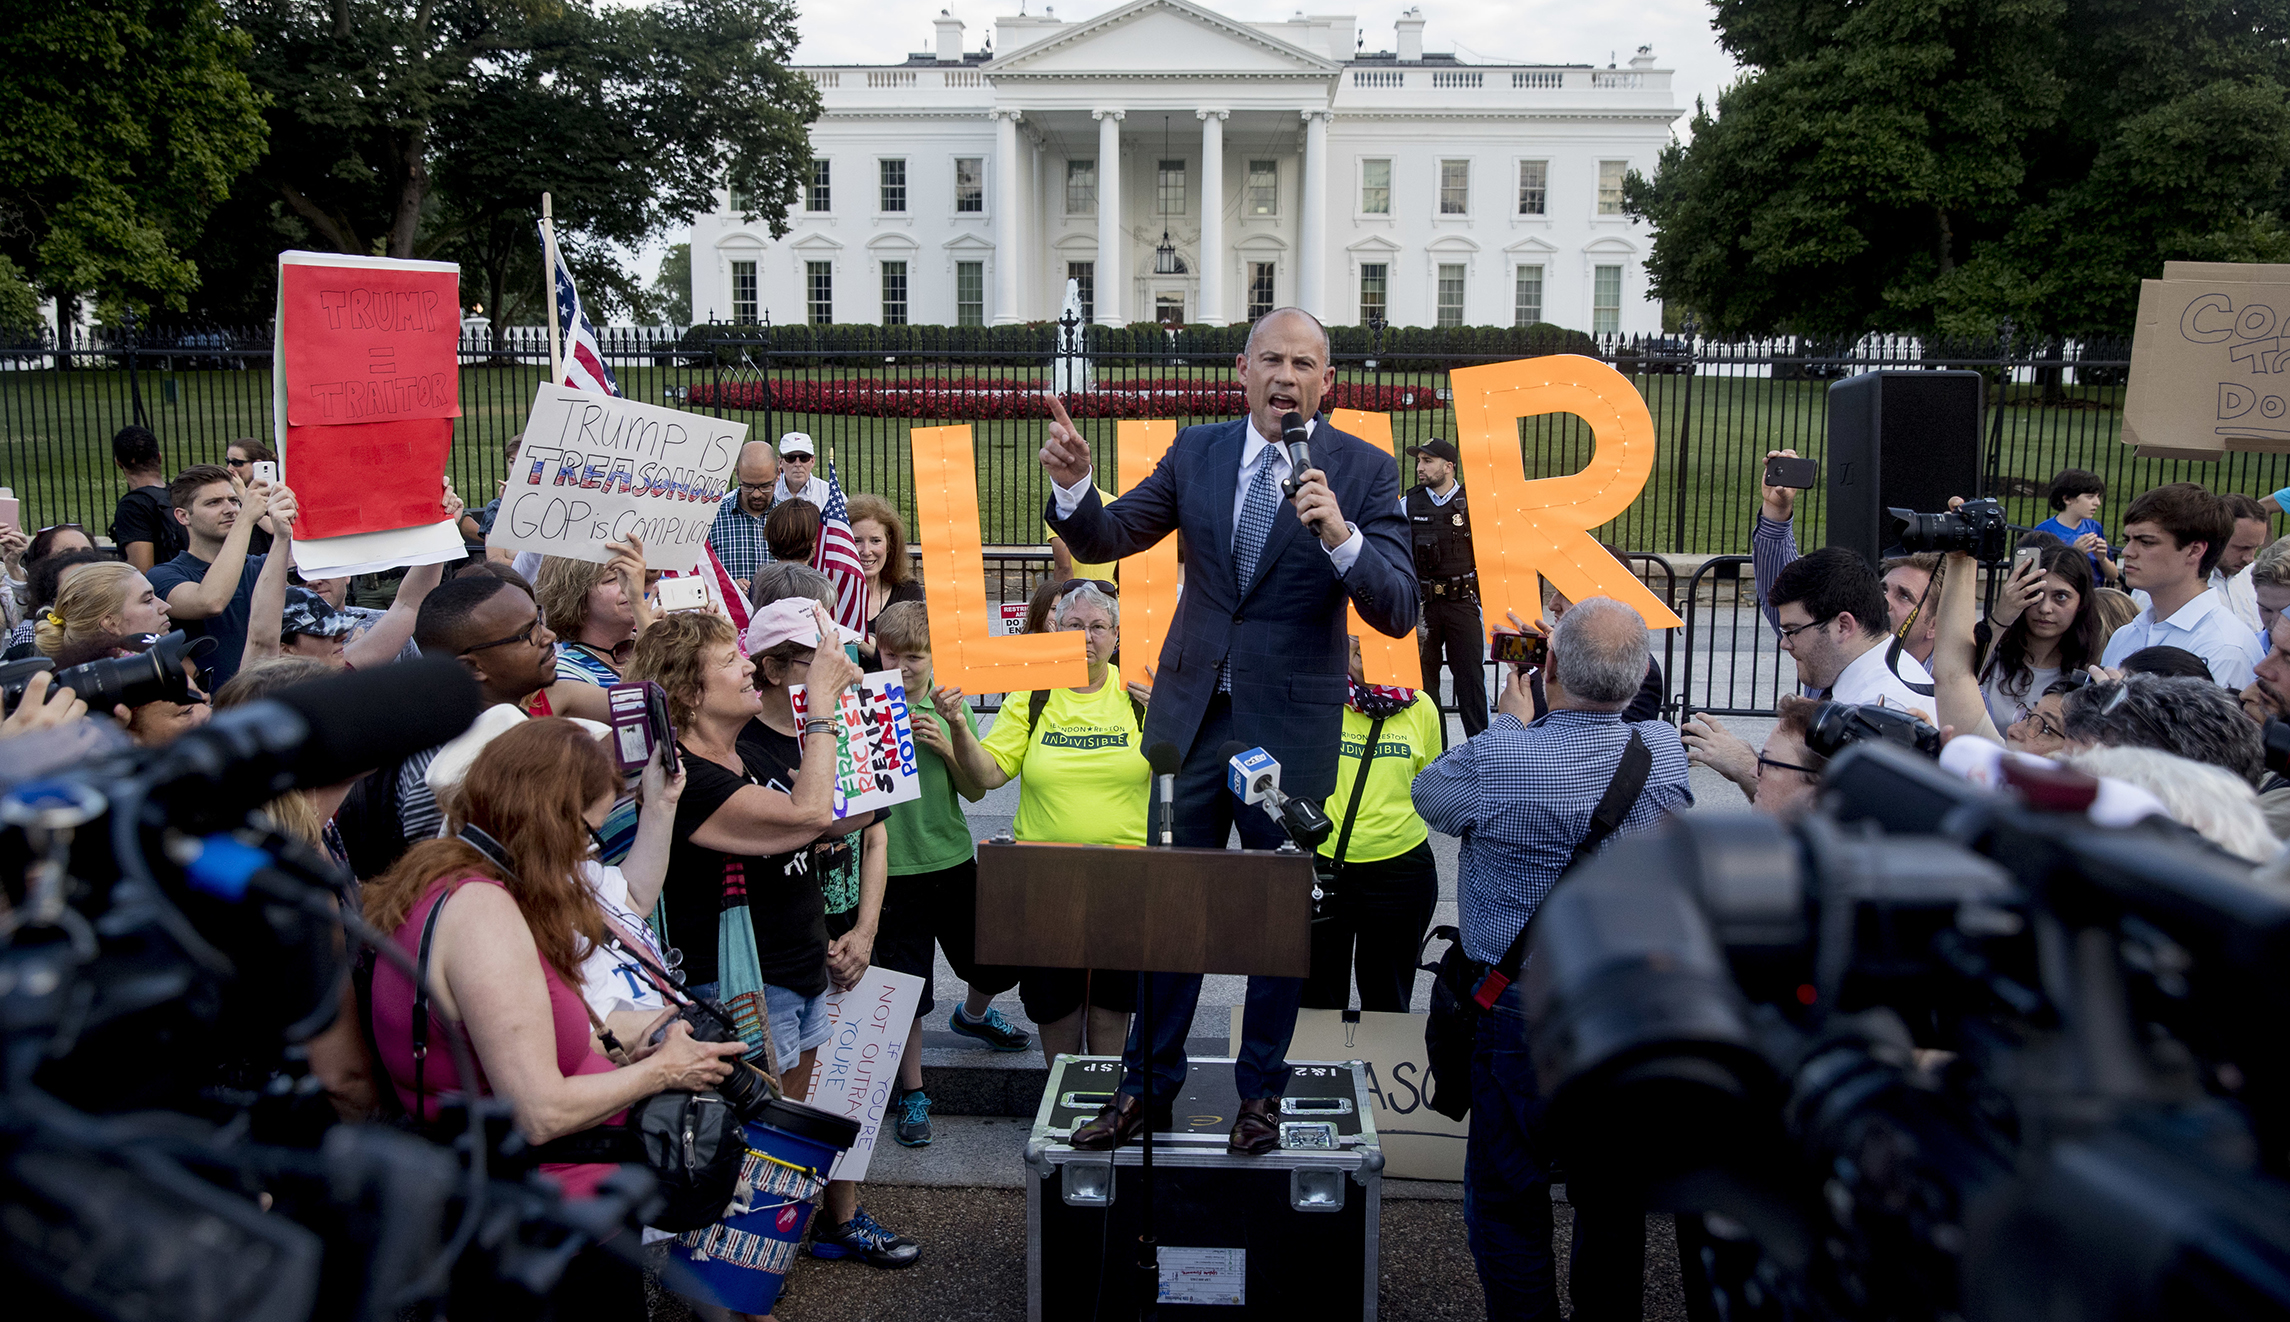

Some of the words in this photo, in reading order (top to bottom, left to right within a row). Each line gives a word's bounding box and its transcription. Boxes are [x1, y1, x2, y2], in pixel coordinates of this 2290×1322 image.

[320, 288, 439, 332] TRUMP
[2180, 293, 2290, 344] CO
[310, 372, 448, 418] TRAITOR
[557, 398, 688, 461] TRUMP
[699, 431, 734, 472] IS
[526, 445, 728, 504] TREASONOUS
[511, 492, 592, 540] GOP
[1006, 619, 1020, 627] DO
[1898, 606, 1919, 639] Nikon
[840, 692, 876, 794] RACIST
[857, 687, 895, 794] SEXIST
[874, 693, 901, 770] NAZI
[884, 682, 917, 777] POTUS
[1045, 735, 1124, 747] INDIVISIBLE
[1050, 723, 1086, 732] ENDON
[1340, 743, 1408, 756] NDIVSIBLE
[1379, 732, 1408, 740] ESTON
[870, 985, 896, 1034] NOT
[844, 1043, 879, 1120] OUTRA
